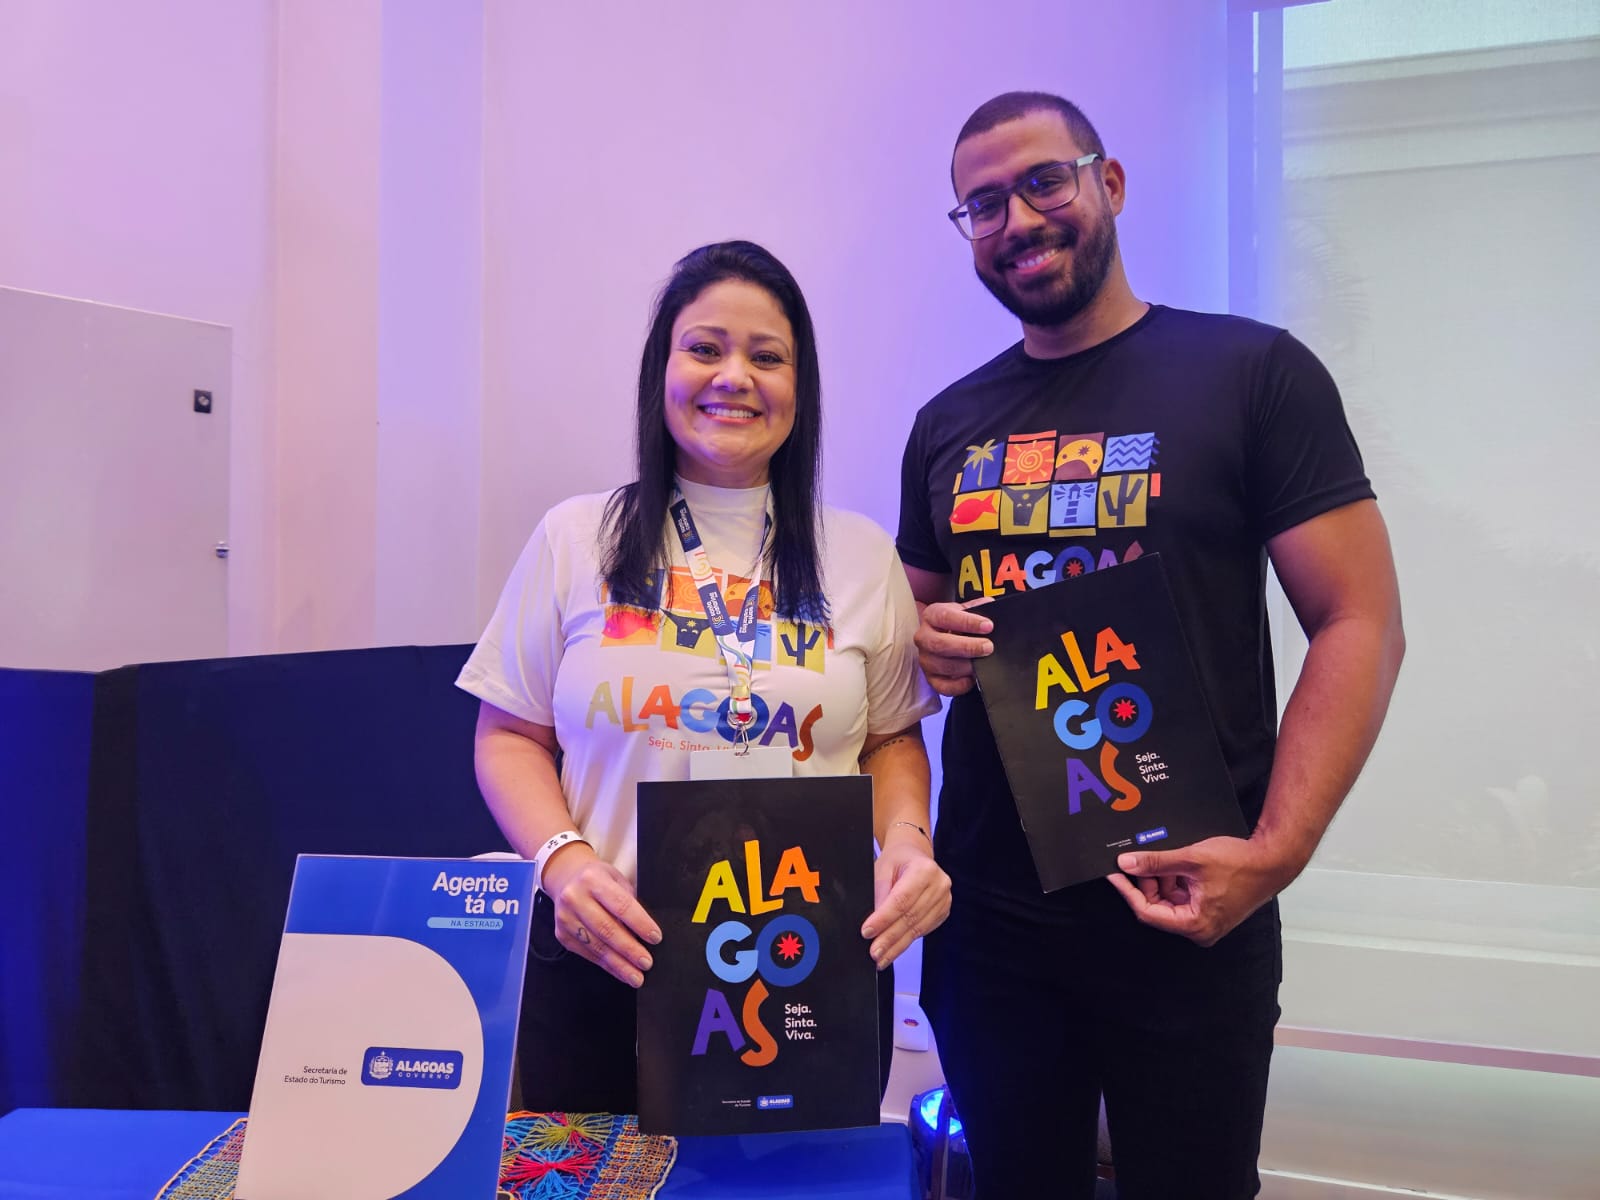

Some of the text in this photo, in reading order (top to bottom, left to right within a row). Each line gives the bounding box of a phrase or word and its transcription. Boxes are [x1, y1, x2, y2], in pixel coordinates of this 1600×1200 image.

[585, 676, 823, 761] ALAGOAS
[648, 736, 676, 750] Seja.
[1135, 752, 1160, 763] Seja.
[1139, 762, 1168, 775] Sinta.
[1142, 773, 1169, 783] Viva.
[432, 871, 509, 896] Agente
[464, 892, 486, 914] tá
[450, 919, 501, 928] NA ESTRADA
[784, 1003, 812, 1016] Seja.
[784, 1017, 817, 1028] Sinta.
[785, 1030, 815, 1040] Viva.
[303, 1065, 338, 1074] Secretaria
[395, 1060, 455, 1074] ALAGOAS
[284, 1075, 309, 1083] Estado
[319, 1077, 346, 1085] Turismo
